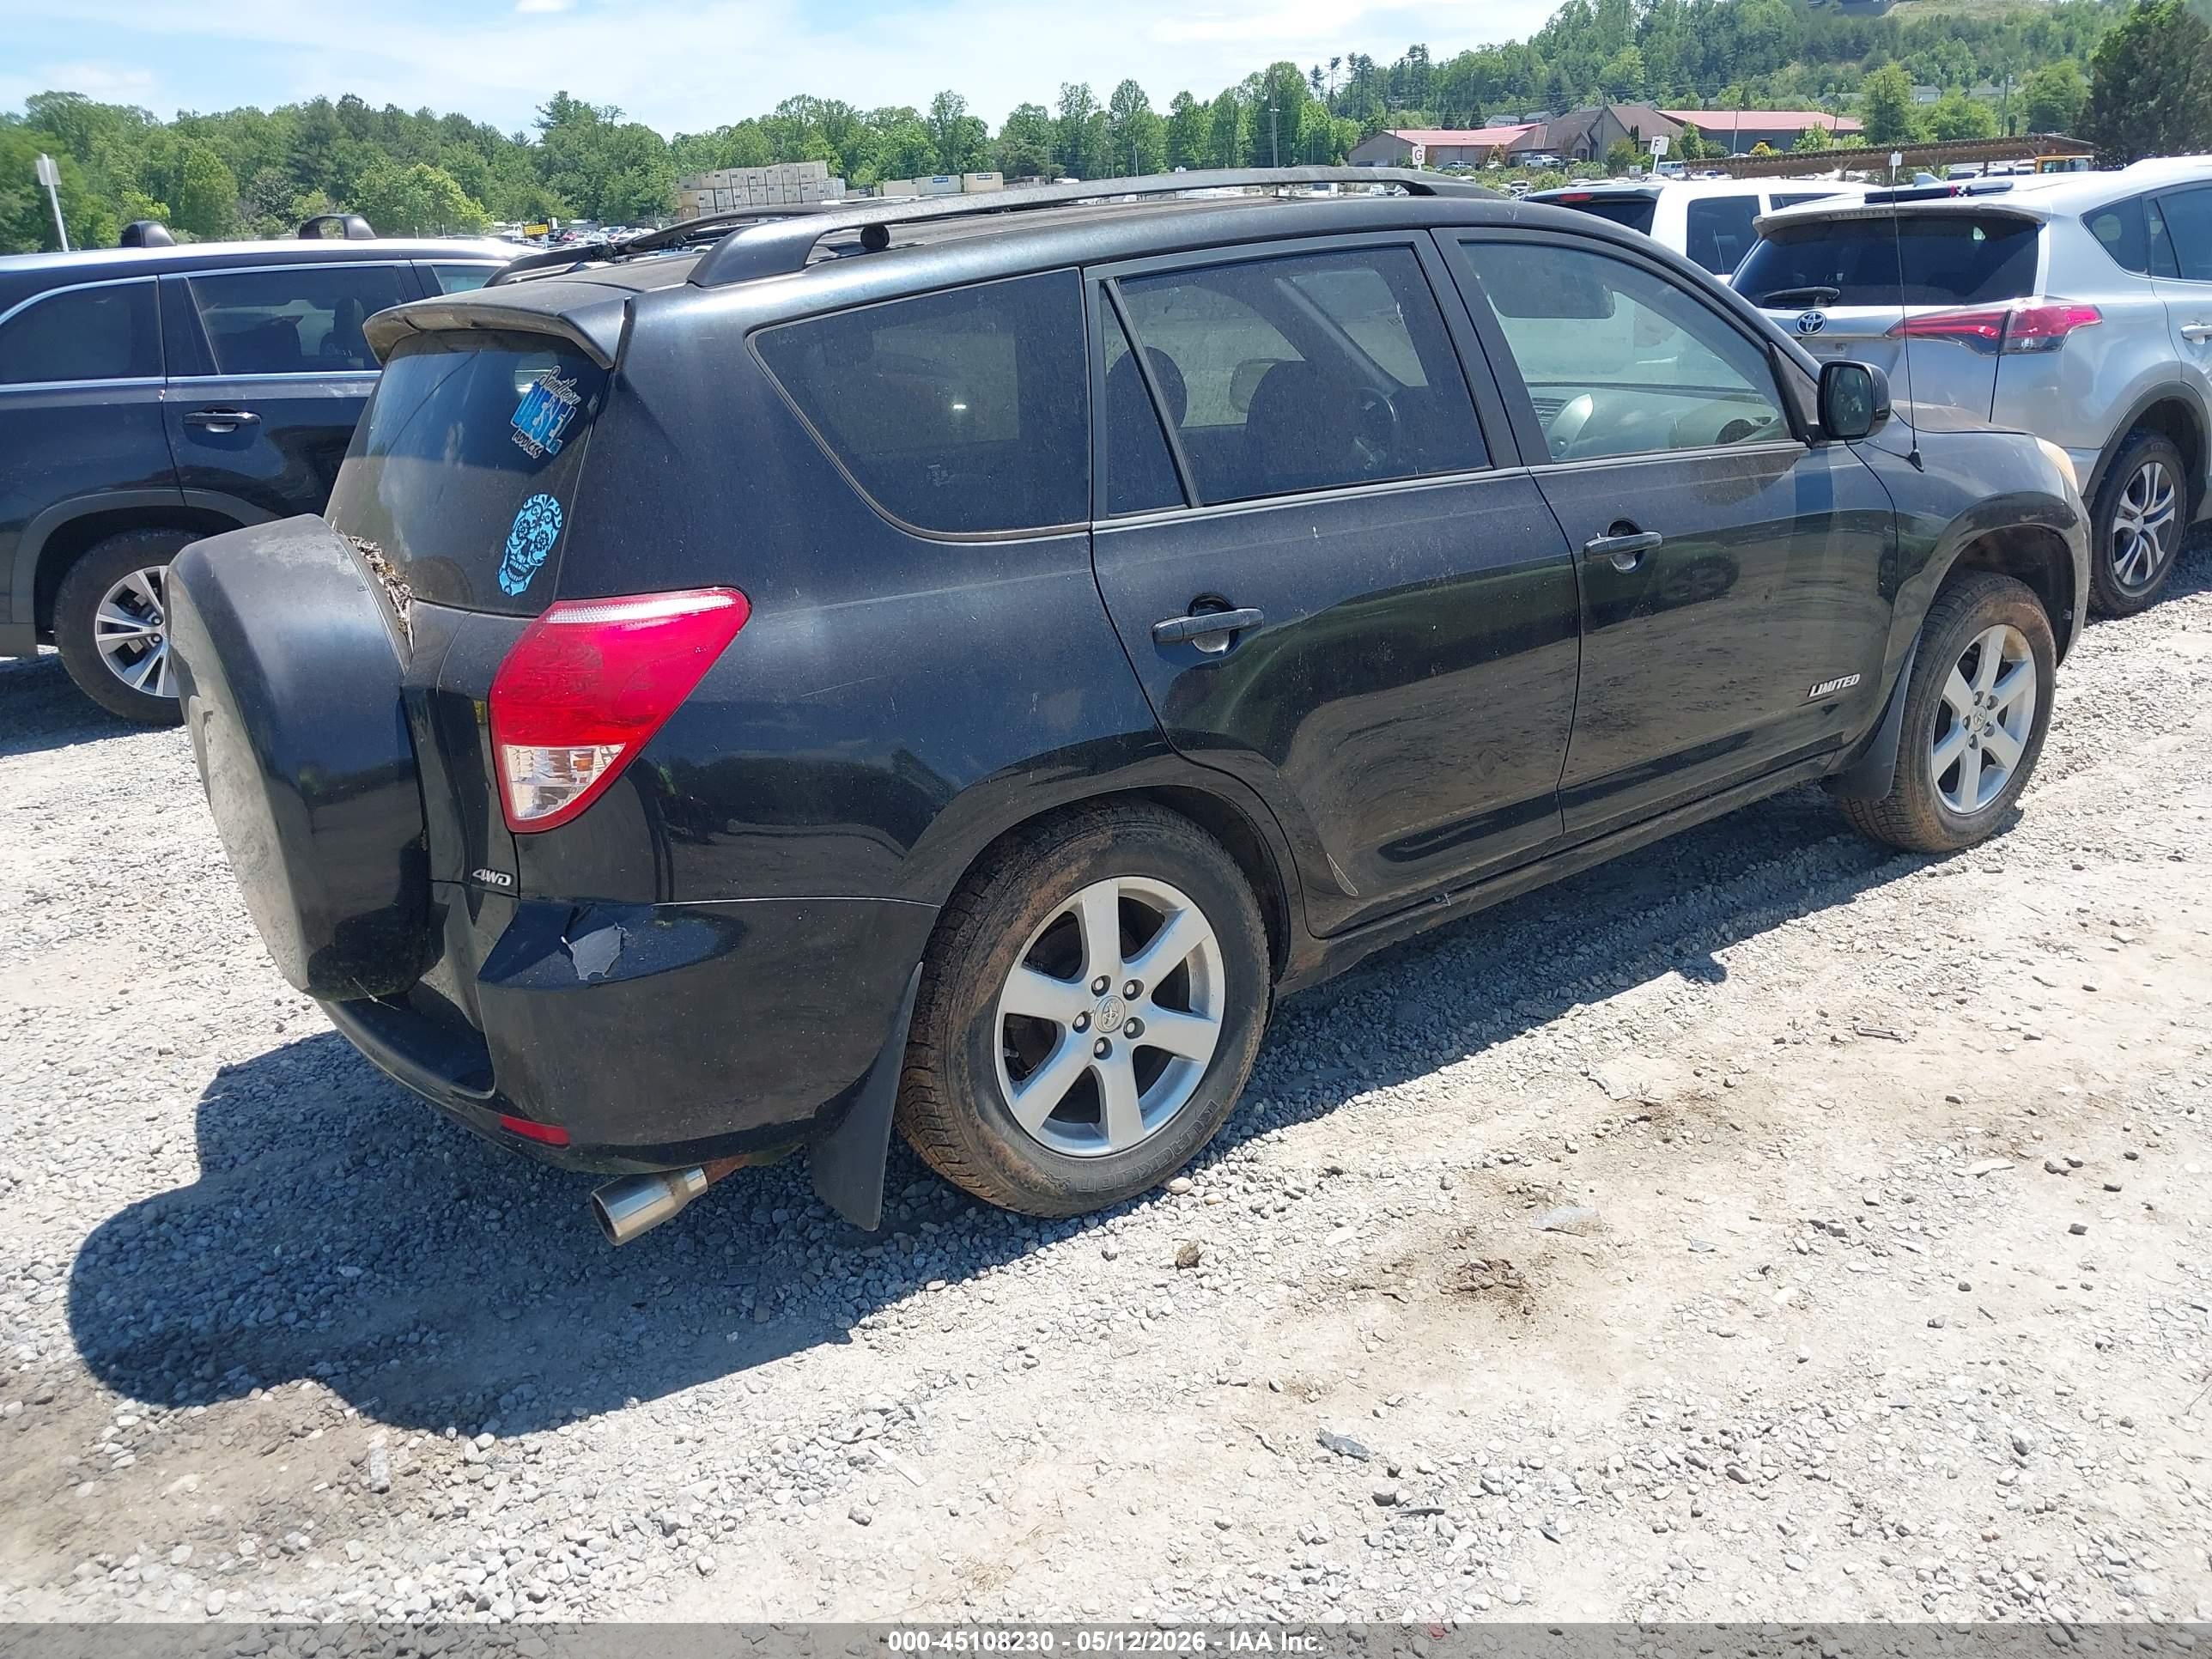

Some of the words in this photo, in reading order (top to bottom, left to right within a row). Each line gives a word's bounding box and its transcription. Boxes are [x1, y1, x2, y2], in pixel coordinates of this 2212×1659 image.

[1414, 149, 1423, 161] G
[1653, 139, 1661, 152] F
[538, 365, 581, 404] Southern
[511, 379, 576, 454] DIESEL
[512, 428, 544, 459] ADDICTS
[1808, 673, 1862, 698] LIMITED
[471, 868, 513, 887] 4WD
